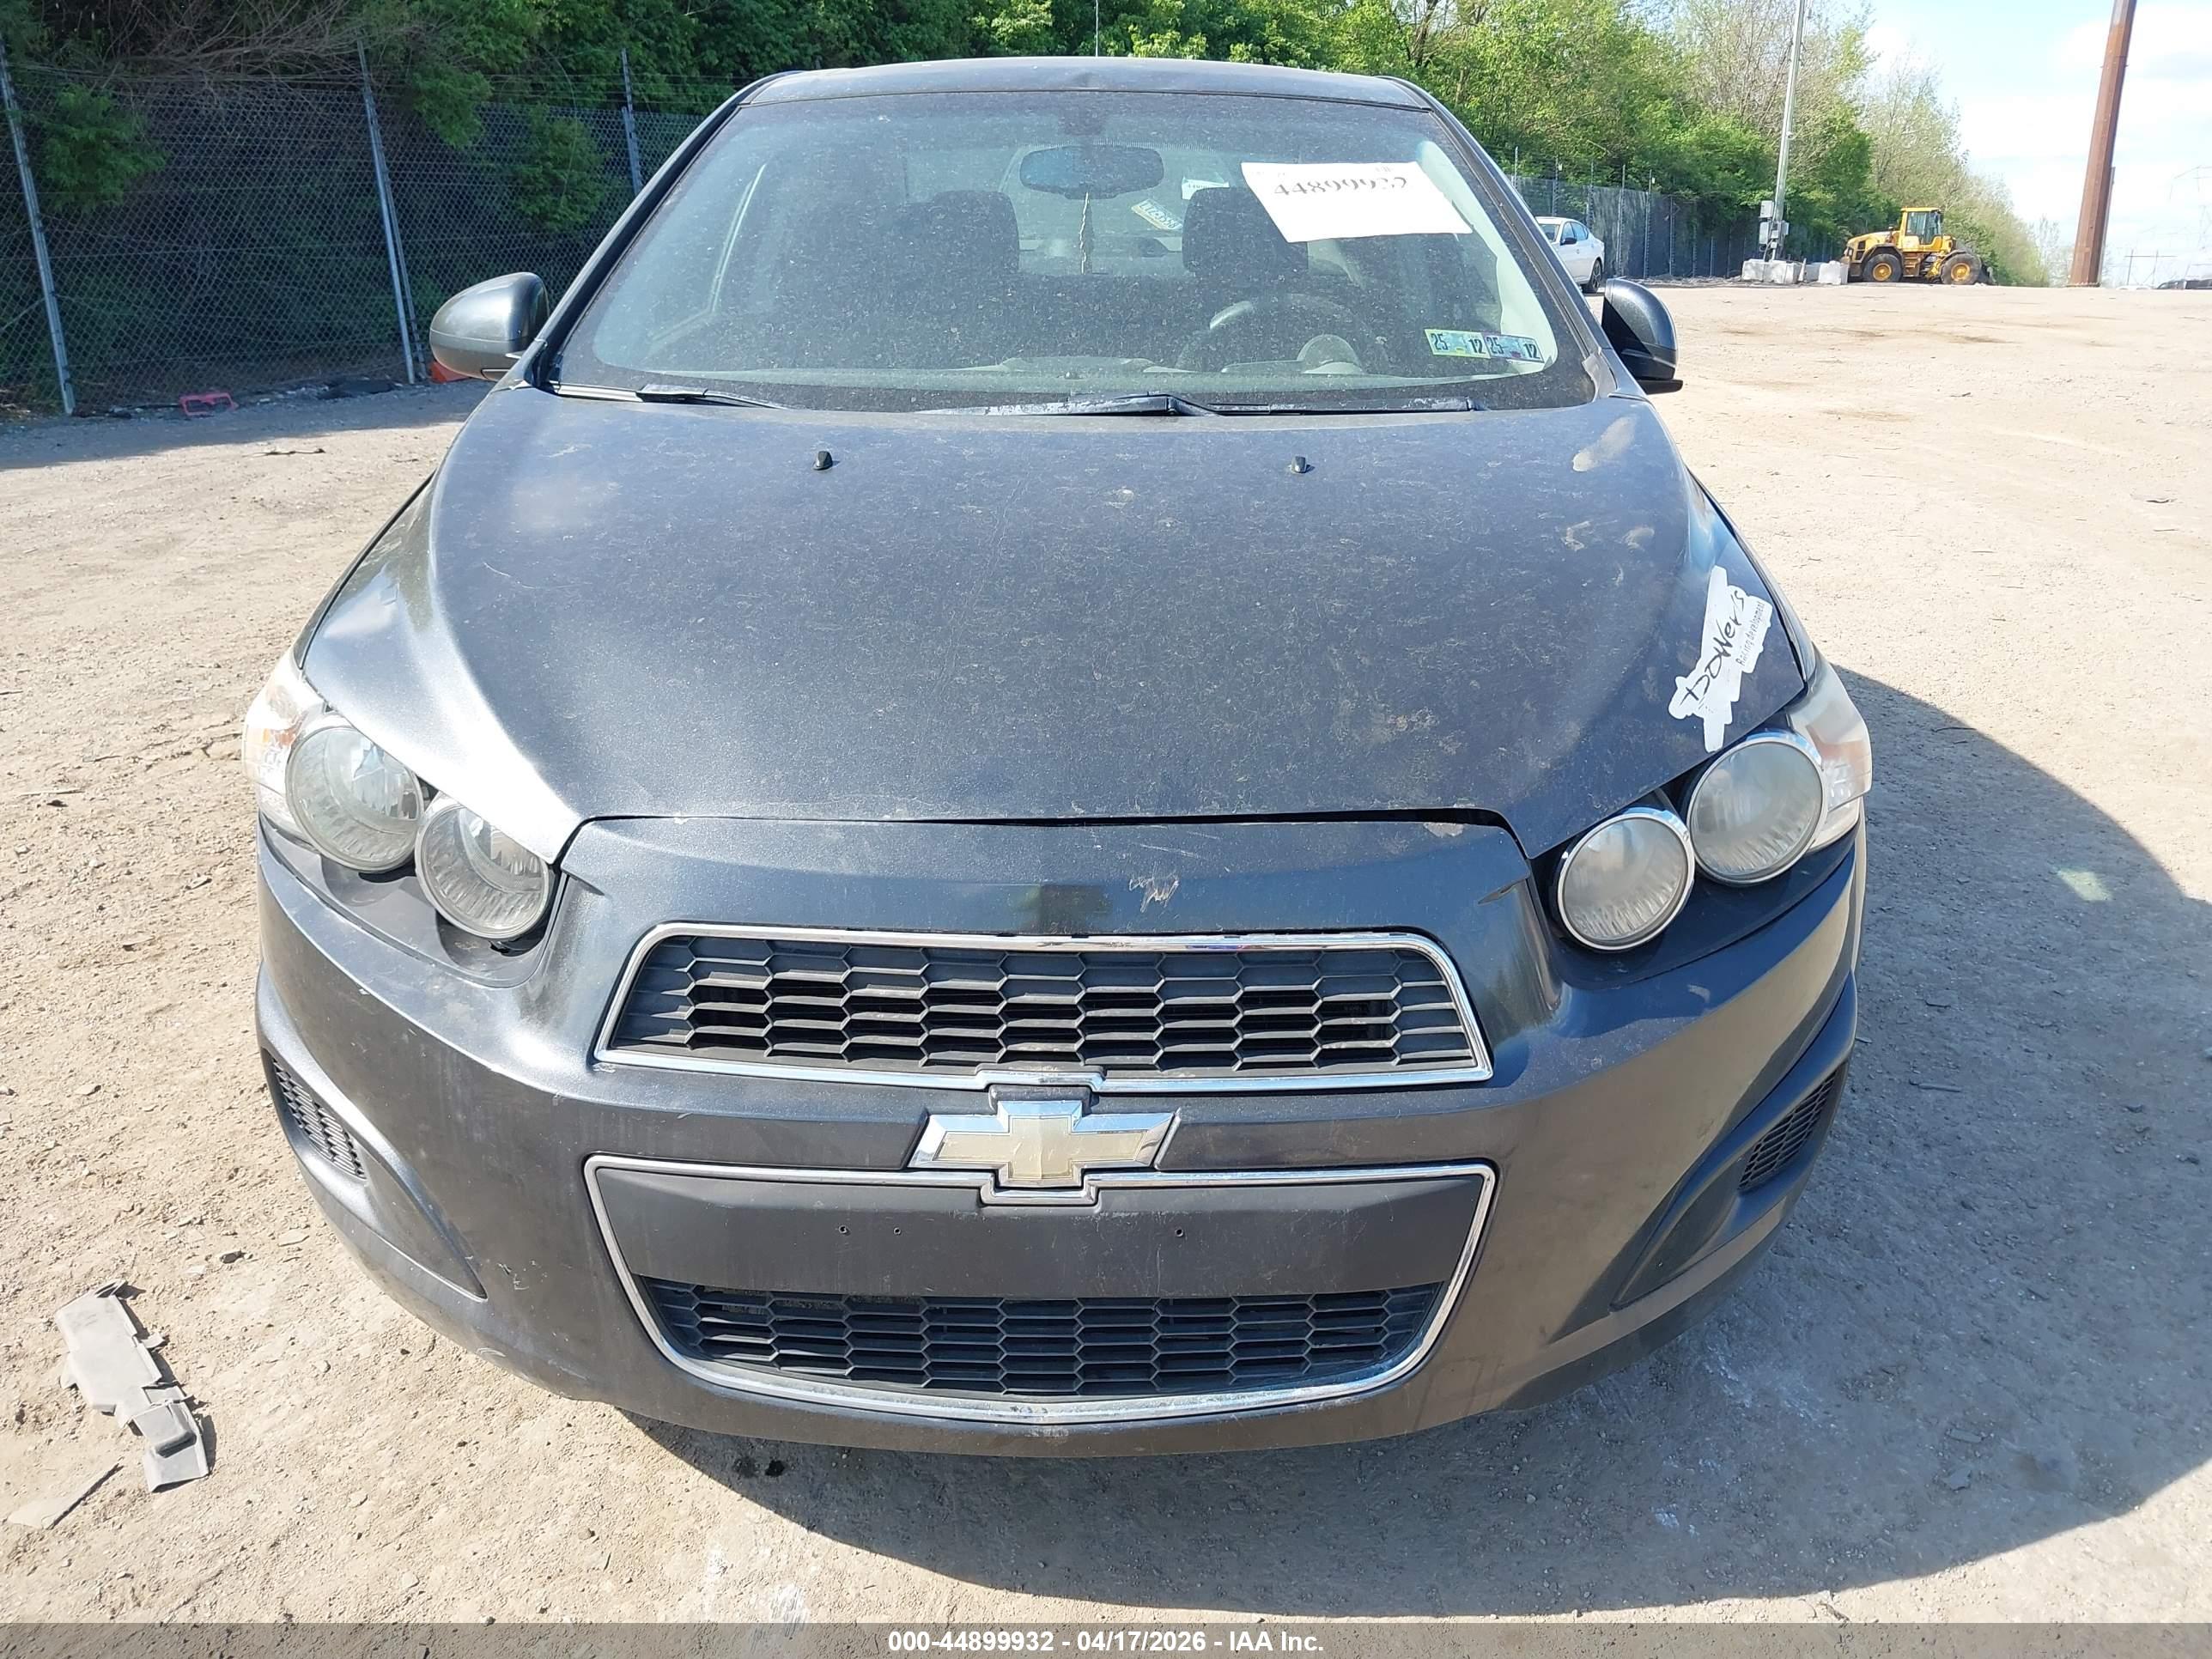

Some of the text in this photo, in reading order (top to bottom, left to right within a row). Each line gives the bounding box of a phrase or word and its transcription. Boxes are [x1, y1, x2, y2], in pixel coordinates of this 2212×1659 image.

[1431, 332, 1486, 355] 25 12
[1486, 336, 1540, 360] 25 12
